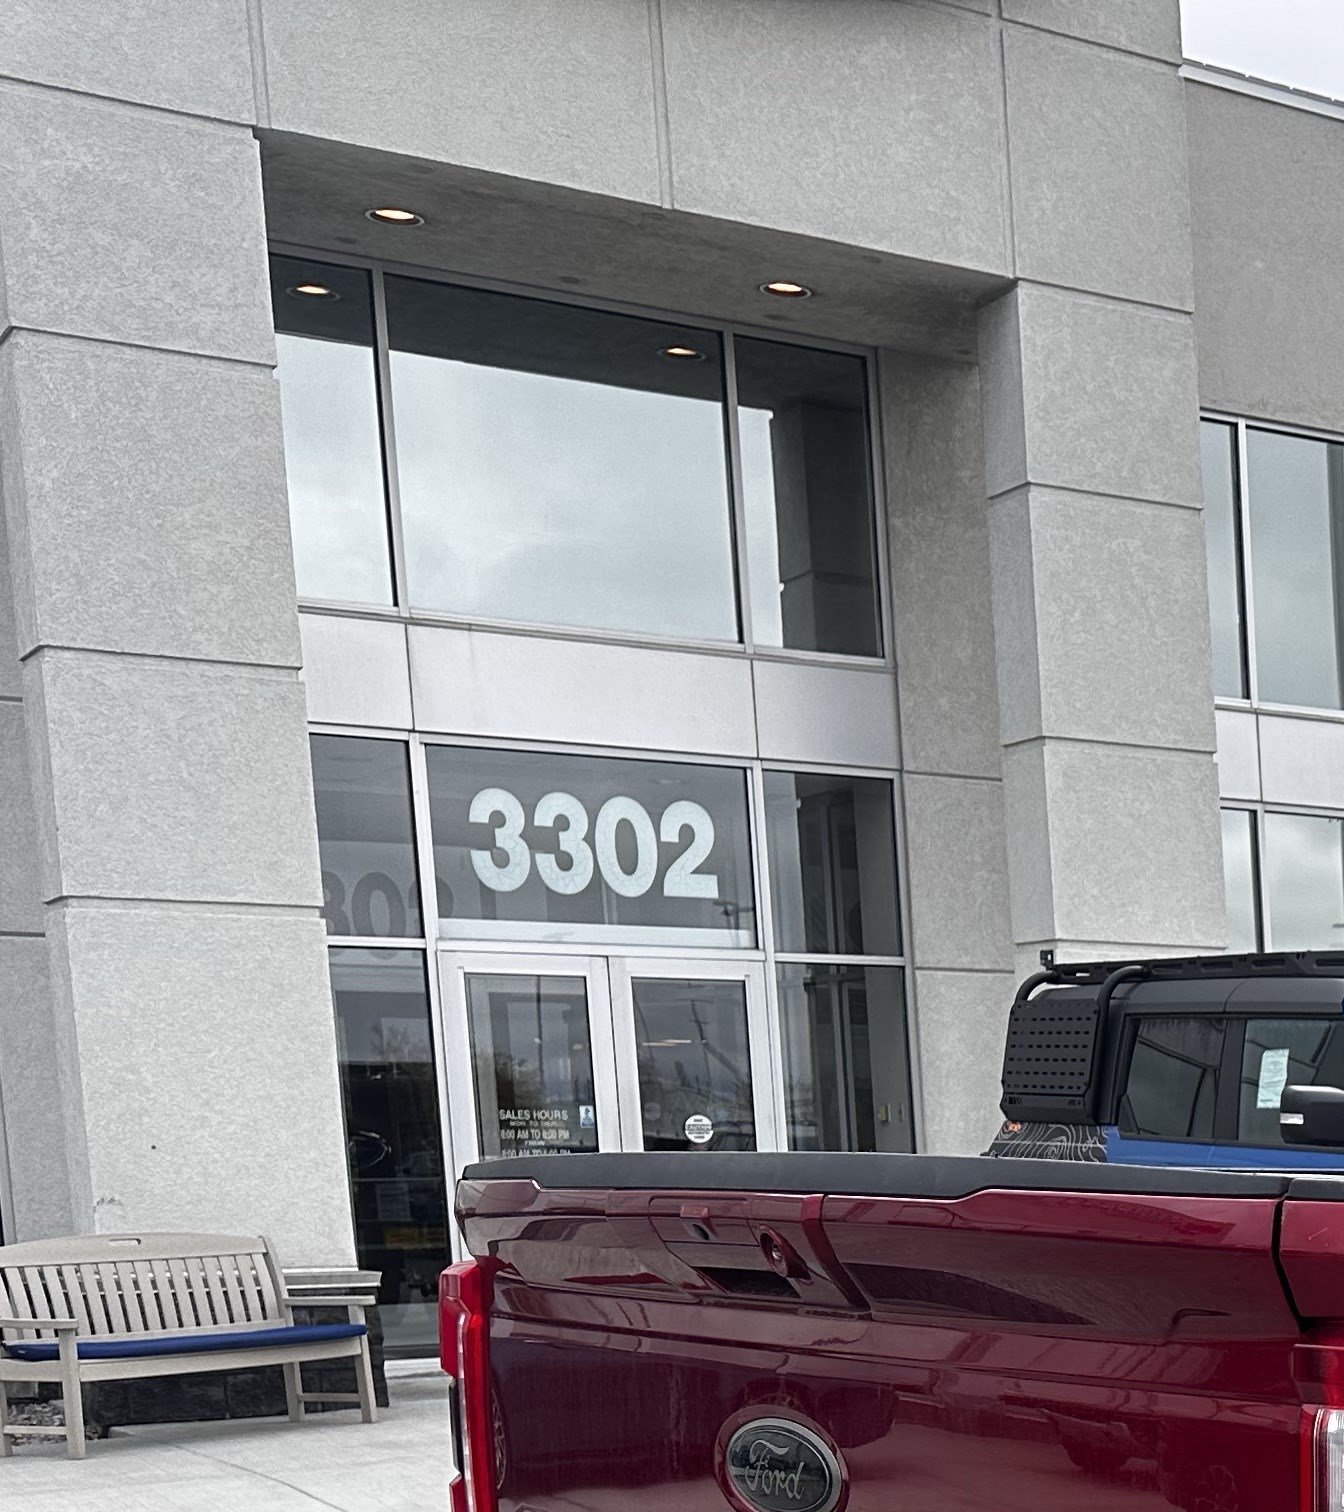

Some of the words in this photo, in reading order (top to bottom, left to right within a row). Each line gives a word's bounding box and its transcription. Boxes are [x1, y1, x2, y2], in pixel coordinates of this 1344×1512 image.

[467, 787, 719, 900] 3302
[499, 1108, 531, 1121] SALES
[533, 1109, 569, 1121] HOURS
[530, 1129, 541, 1140] TO
[742, 1439, 807, 1501] Ford
